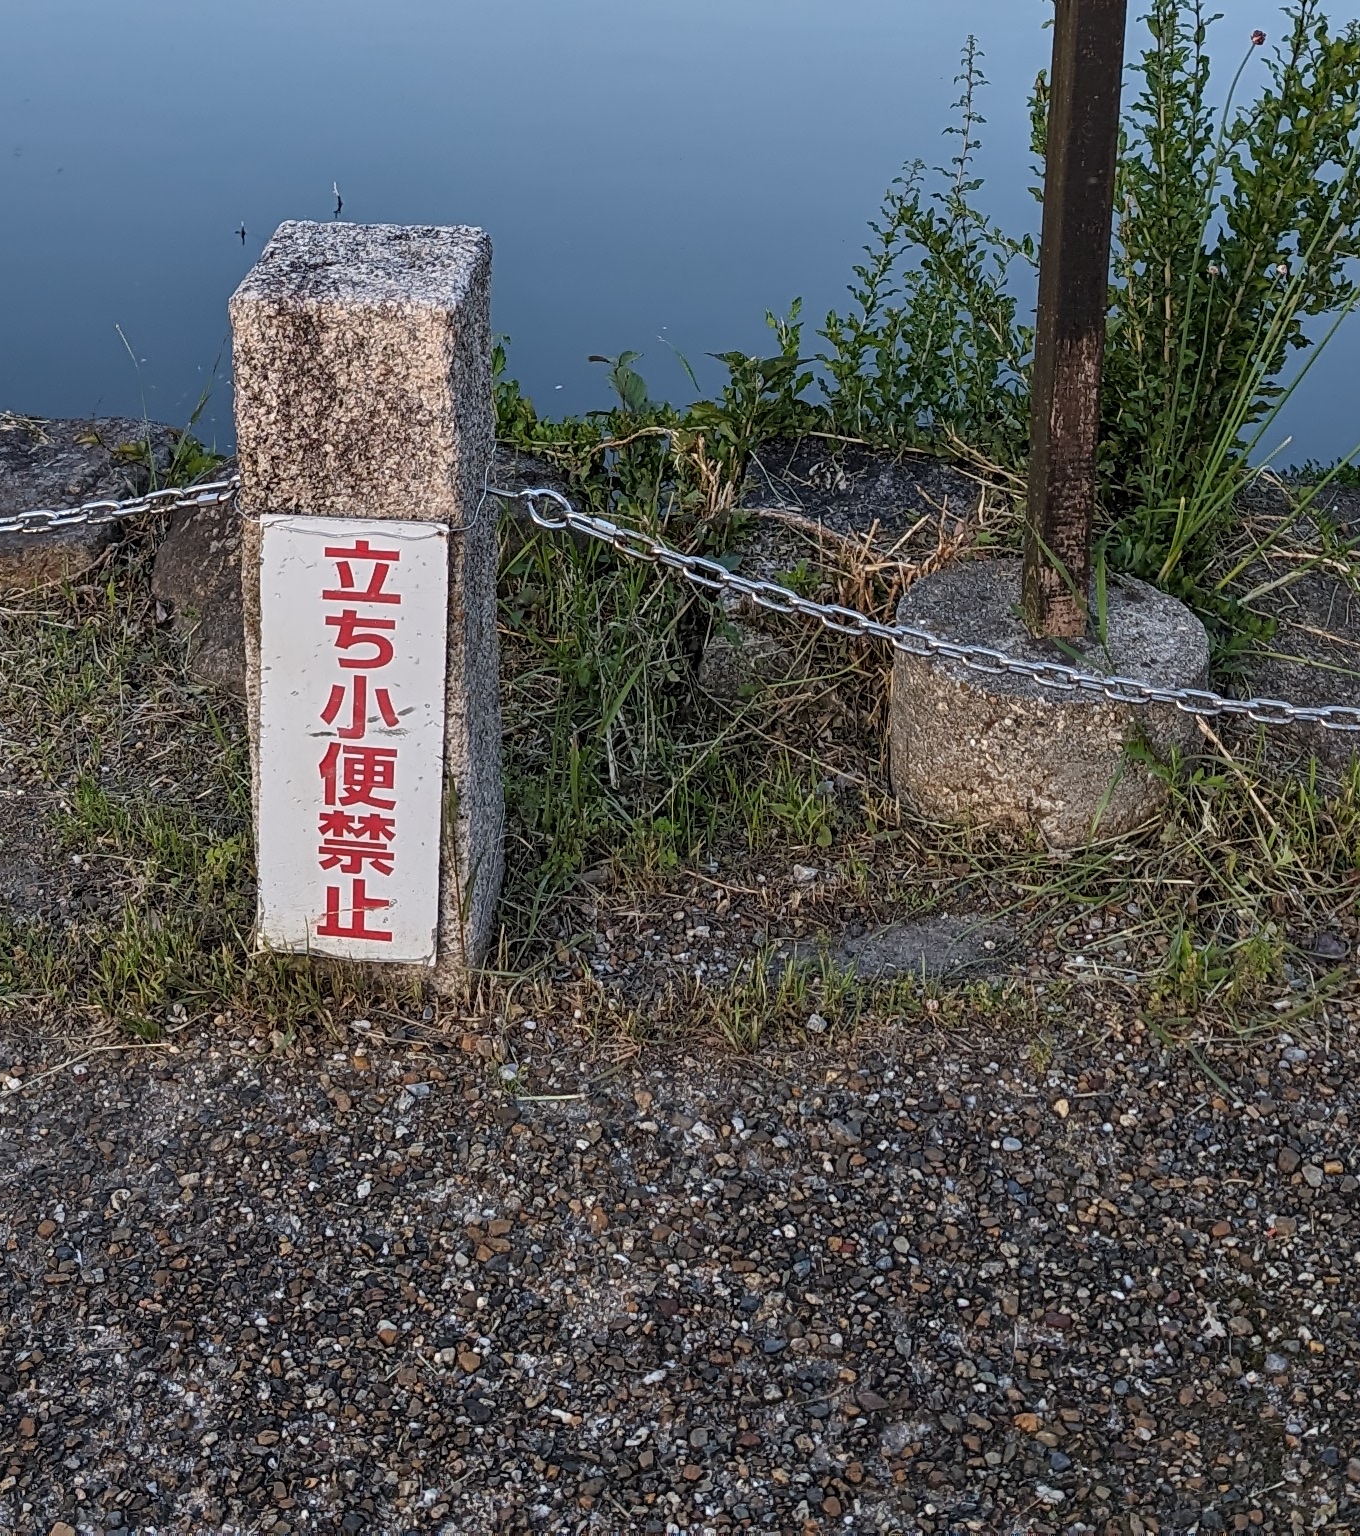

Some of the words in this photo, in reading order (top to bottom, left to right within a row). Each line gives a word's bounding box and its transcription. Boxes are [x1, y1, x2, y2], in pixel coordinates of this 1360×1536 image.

[316, 539, 403, 943] 立ち小便禁止
